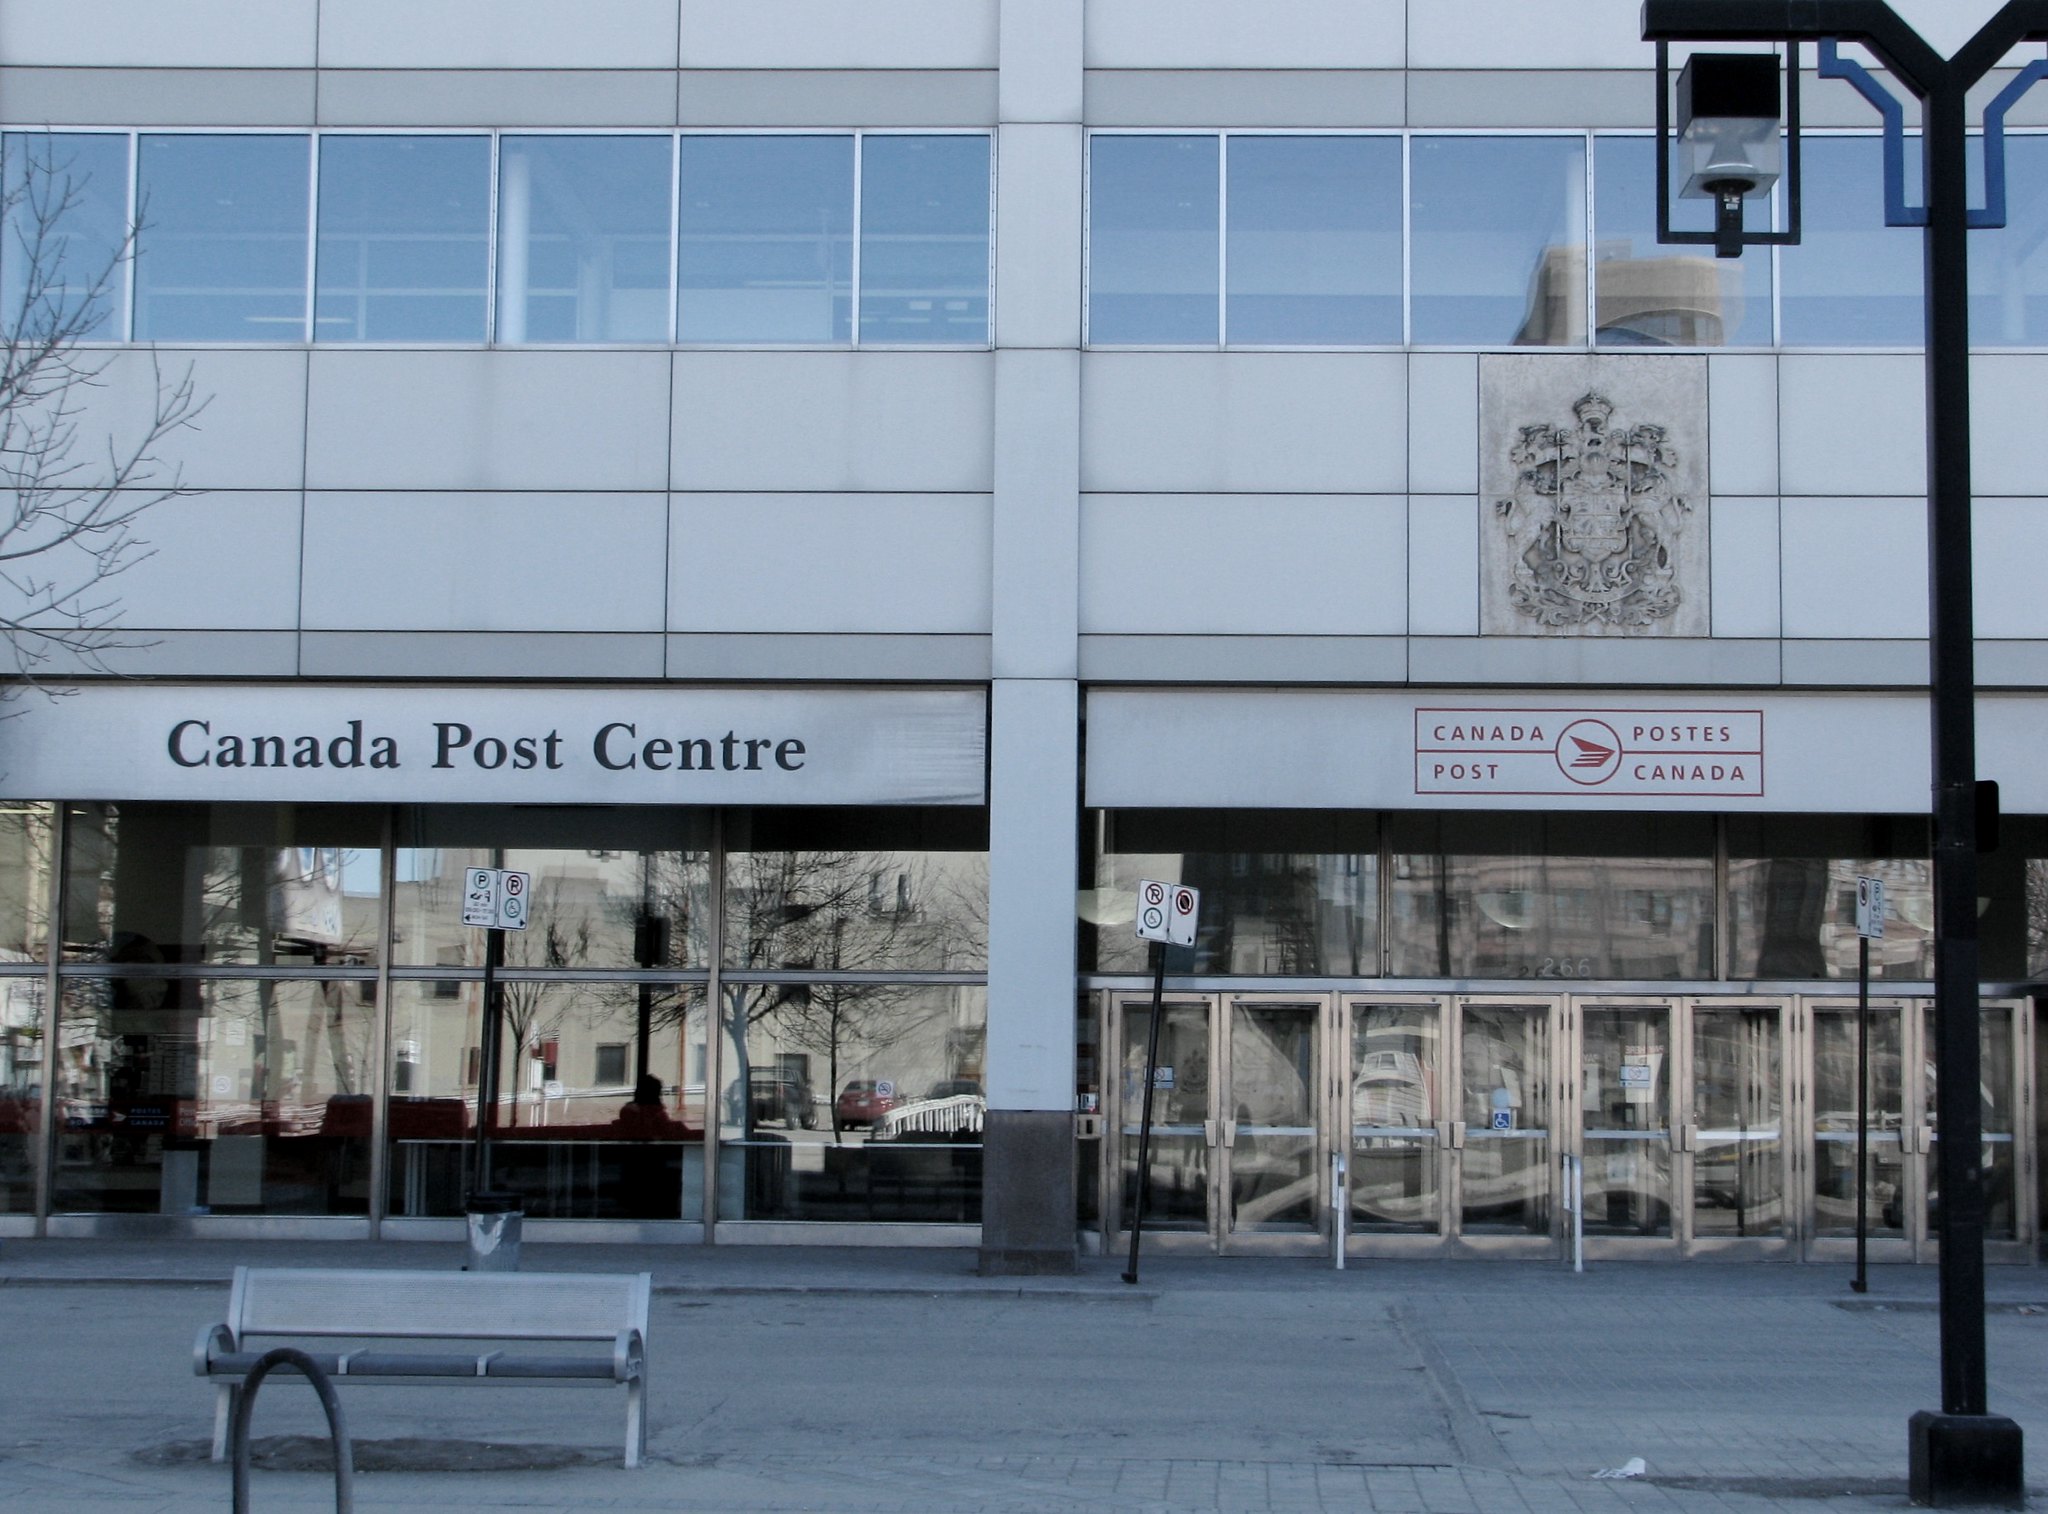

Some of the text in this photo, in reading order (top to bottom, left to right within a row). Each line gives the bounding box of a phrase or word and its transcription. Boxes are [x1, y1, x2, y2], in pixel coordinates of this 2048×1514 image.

[1433, 725, 1545, 742] CANADA
[1633, 725, 1731, 743] POSTES
[167, 719, 807, 772] Canada Post Centre
[1434, 763, 1499, 780] POST
[1633, 764, 1745, 781] CANADA
[478, 875, 487, 885] P
[1541, 957, 1591, 977] 266
